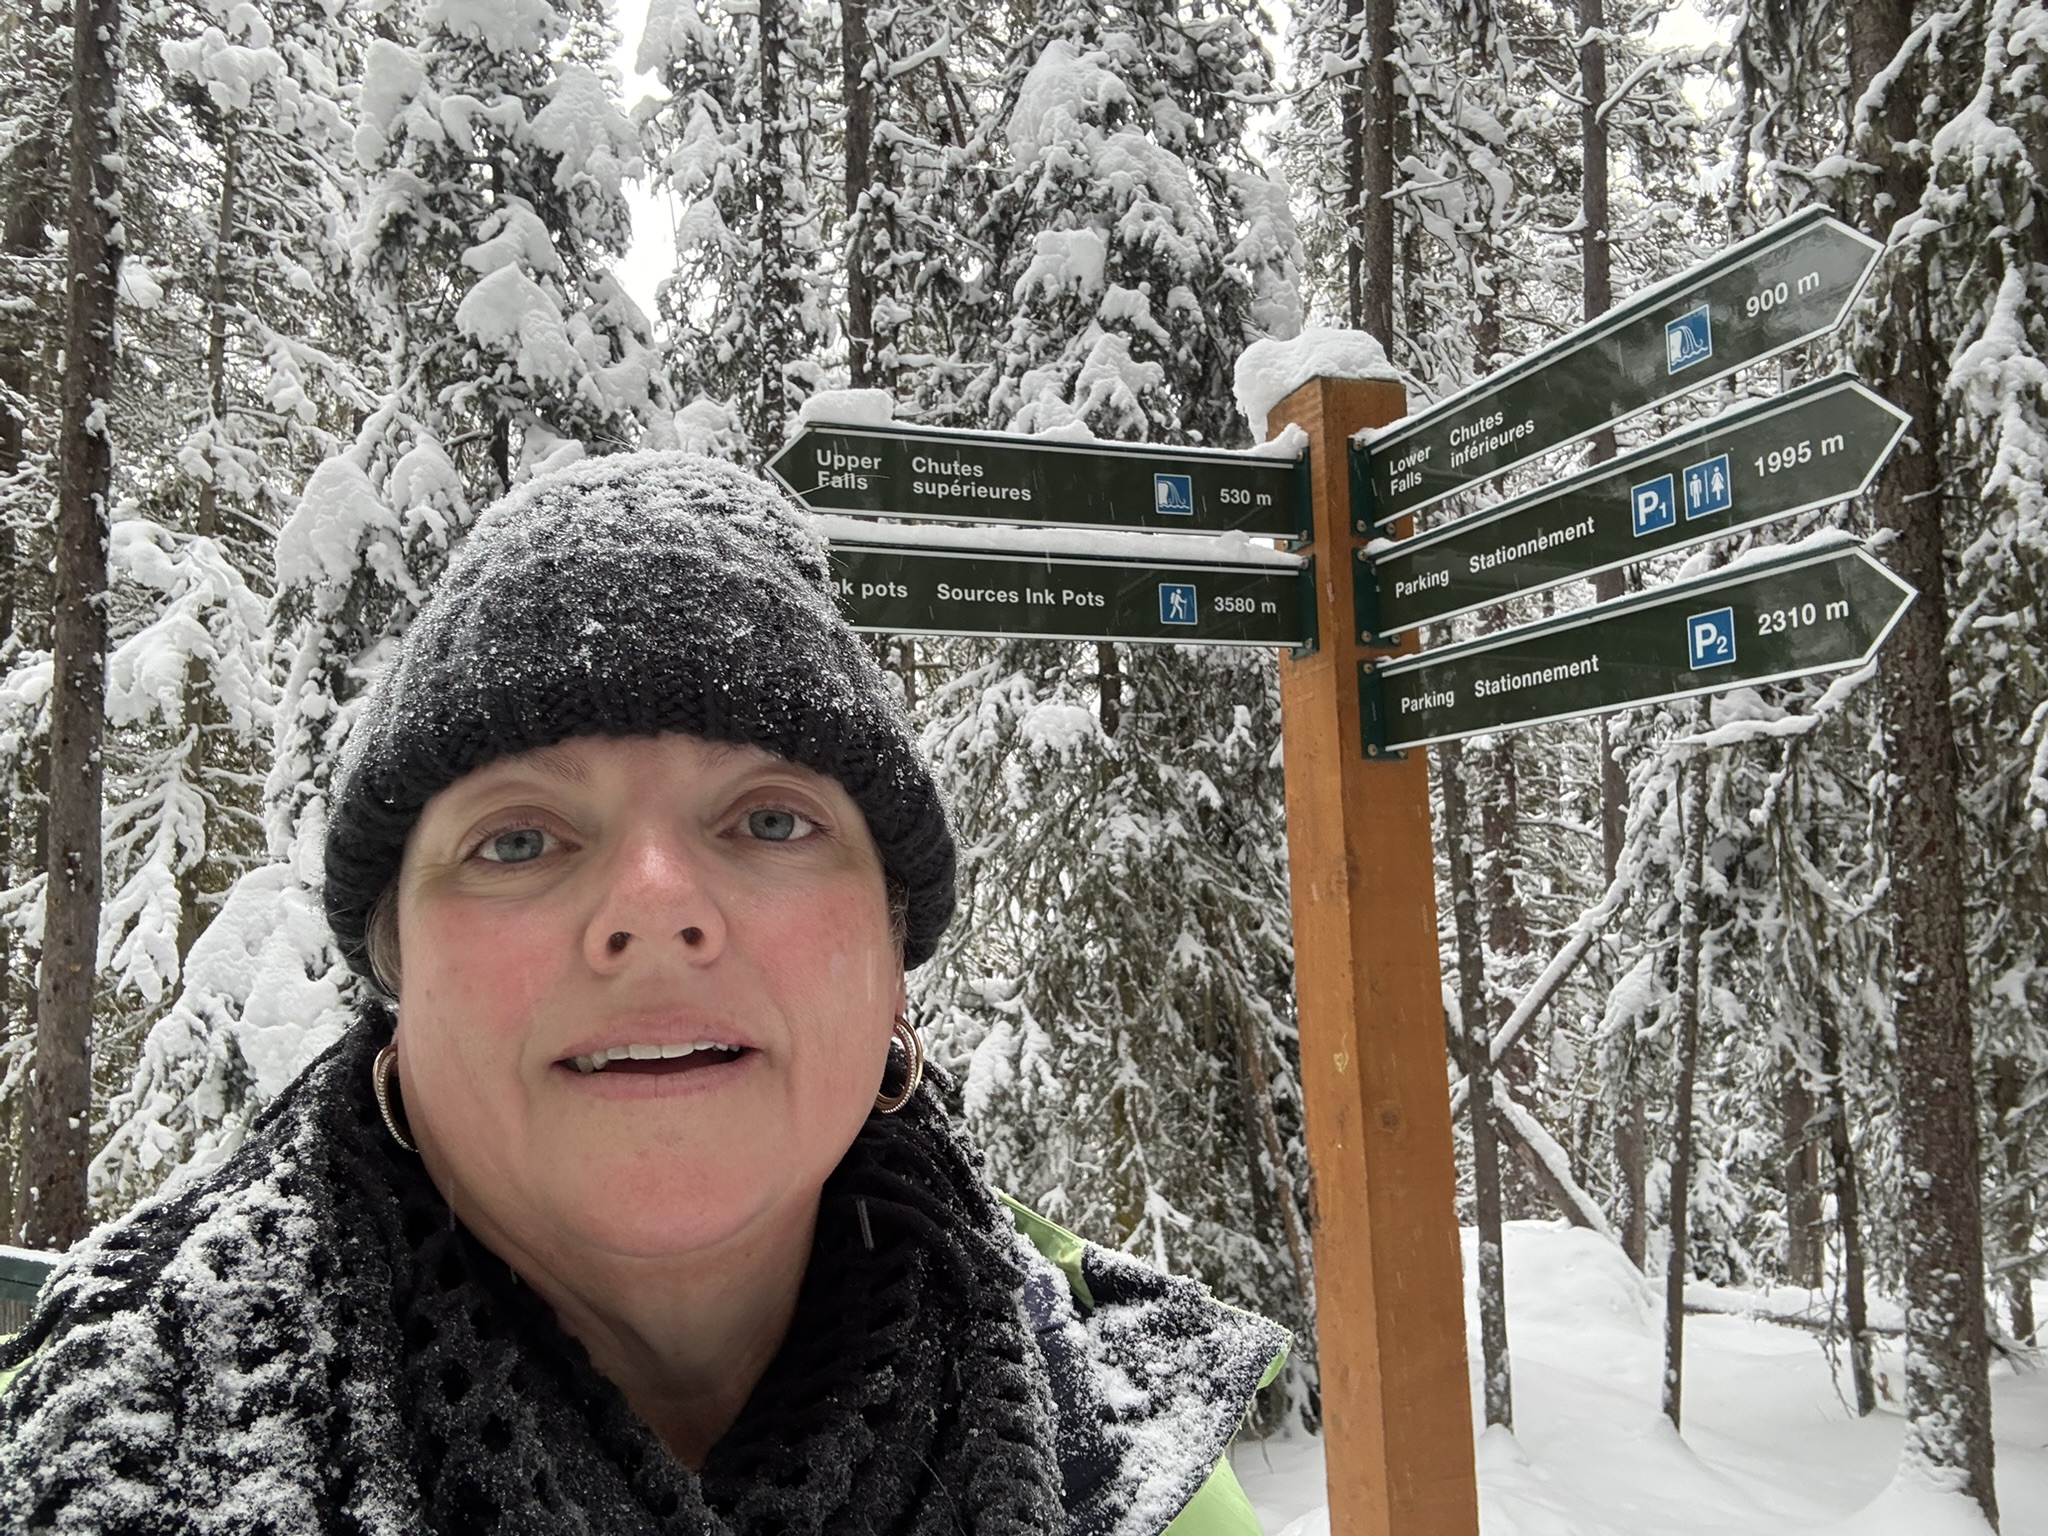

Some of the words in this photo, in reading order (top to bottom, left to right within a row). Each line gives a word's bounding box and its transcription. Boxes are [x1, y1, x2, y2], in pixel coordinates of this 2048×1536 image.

[1746, 283, 1789, 317] 900
[1798, 270, 1820, 294] m
[1449, 411, 1504, 448] Chutes
[1450, 417, 1535, 468] inférieures
[816, 449, 882, 473] Upper
[912, 456, 984, 478] Chutes
[1389, 445, 1432, 476] Lower
[817, 470, 868, 490] Falls
[913, 479, 1032, 502] supérieures
[1390, 470, 1422, 496] Falls
[1219, 488, 1252, 505] 530
[1256, 494, 1272, 506] m
[1395, 568, 1449, 599] Parking
[1469, 517, 1595, 574] Stationnement
[1754, 441, 1812, 478] 1995
[1821, 433, 1845, 454] m
[829, 578, 854, 596] nk
[861, 581, 908, 599] pots
[937, 583, 1019, 604] Sources
[1025, 587, 1055, 606] Ink
[1062, 588, 1105, 608] Pots
[1214, 597, 1256, 614] 3580
[1260, 602, 1276, 615] m
[1401, 689, 1455, 714] Parking
[1474, 655, 1600, 699] Stationnement
[1758, 602, 1817, 636] 2310
[1825, 599, 1850, 619] m
